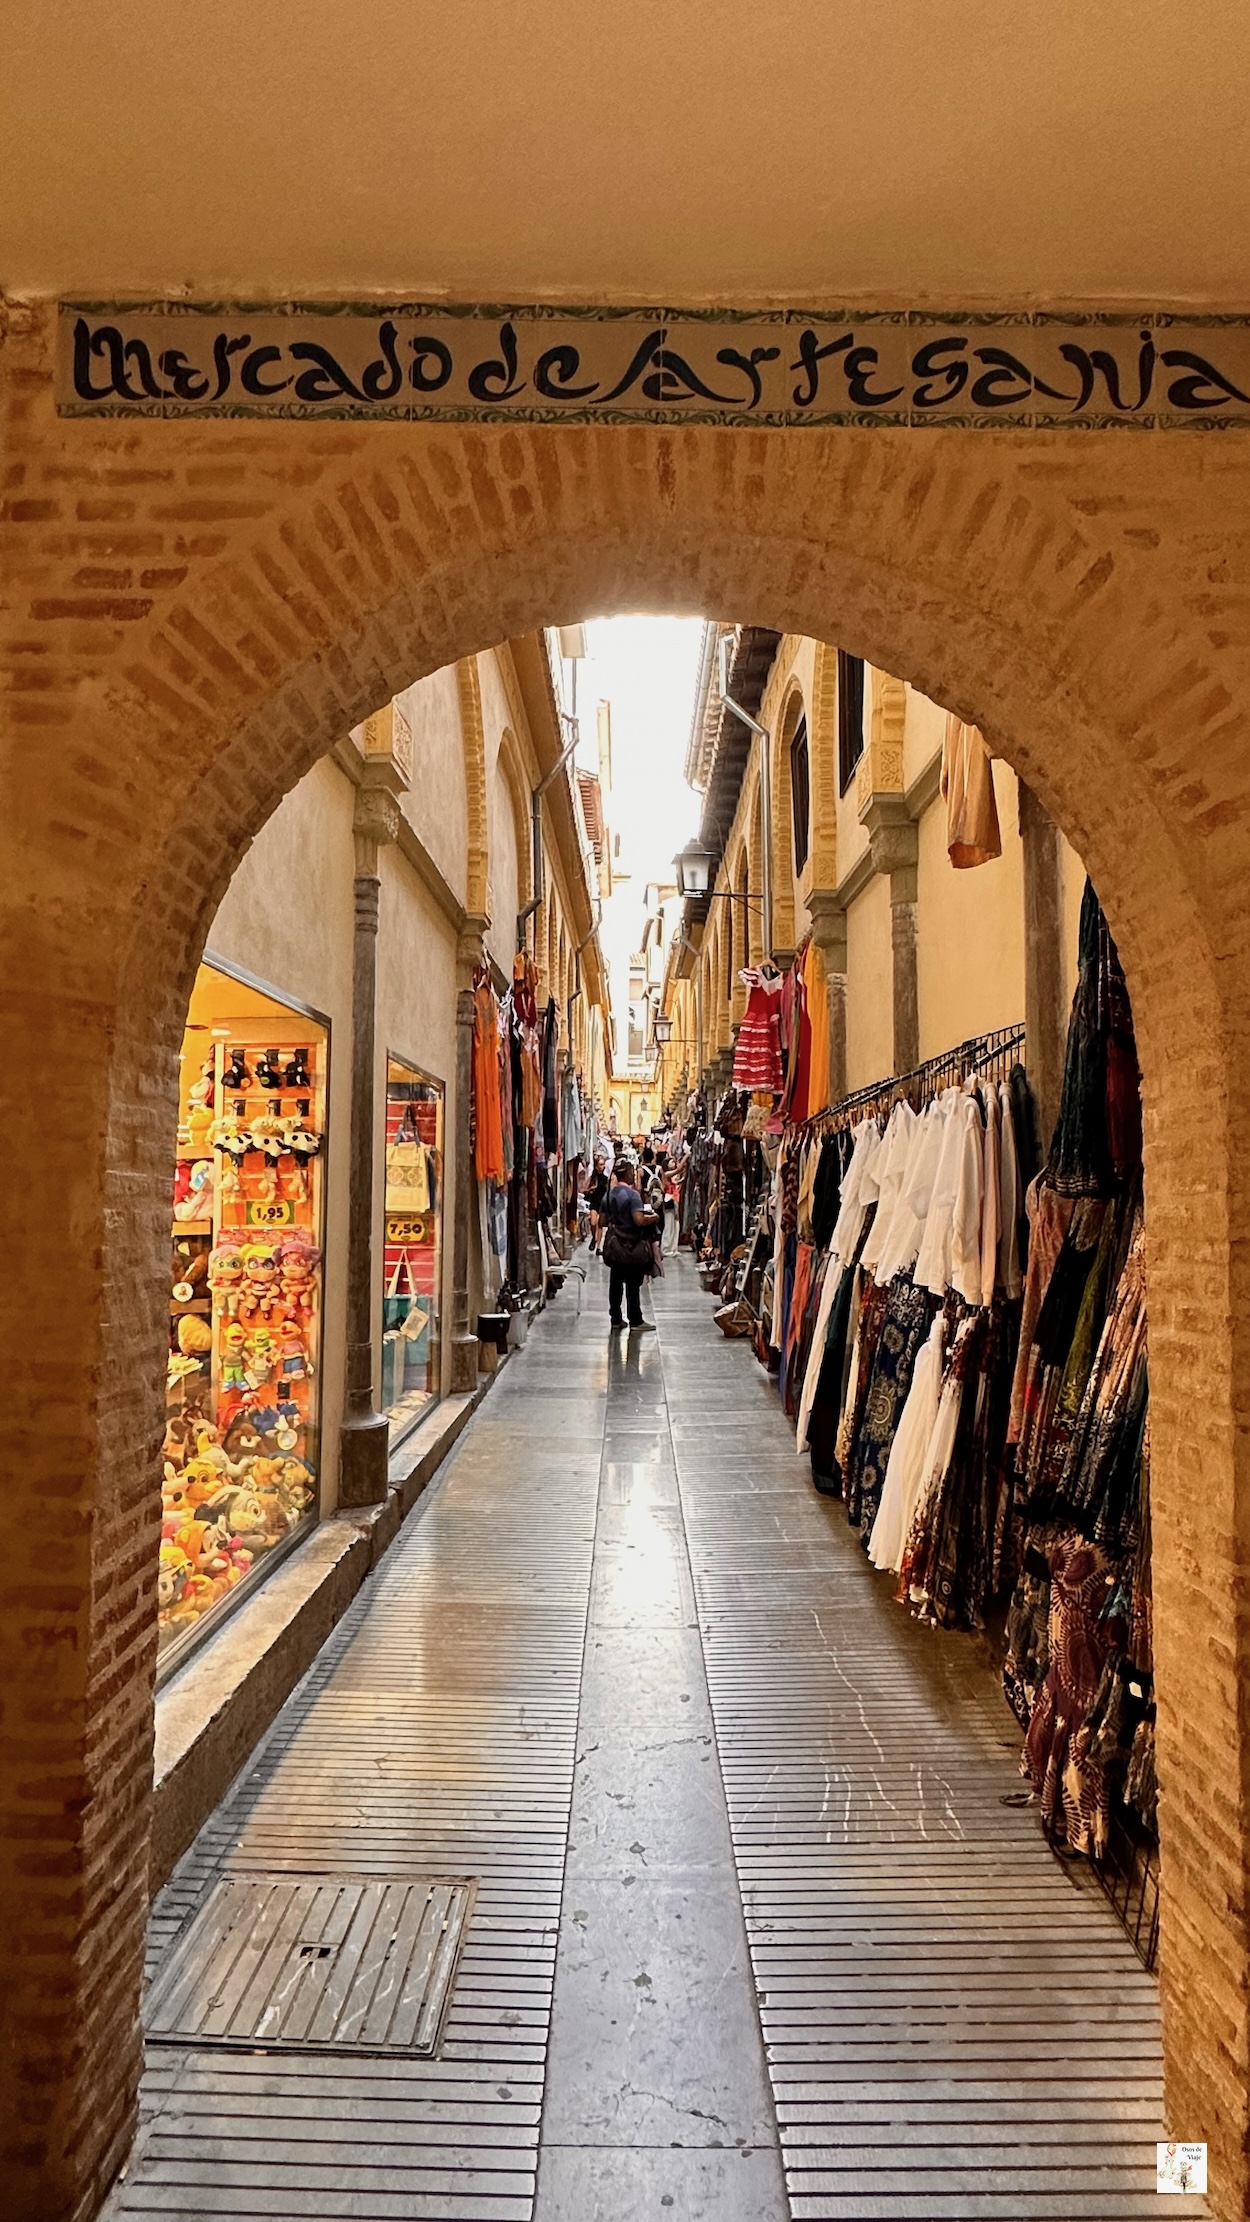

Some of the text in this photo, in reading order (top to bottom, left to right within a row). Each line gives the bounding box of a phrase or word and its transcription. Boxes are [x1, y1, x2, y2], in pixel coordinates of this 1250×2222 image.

[73, 318, 452, 402] Mercado
[468, 322, 599, 400] de
[256, 1207, 284, 1221] 1,95
[390, 1223, 422, 1236] 7,50
